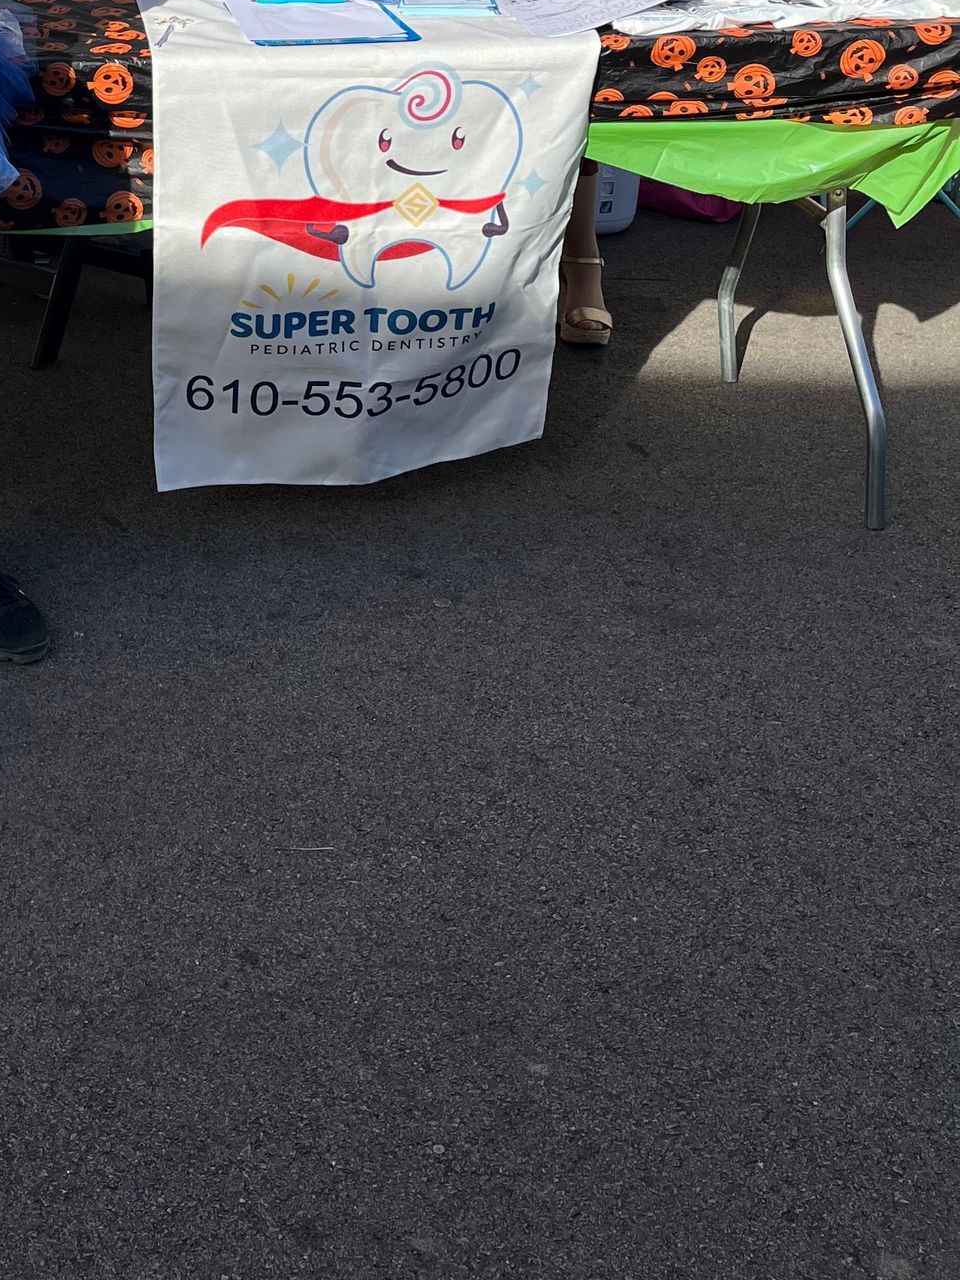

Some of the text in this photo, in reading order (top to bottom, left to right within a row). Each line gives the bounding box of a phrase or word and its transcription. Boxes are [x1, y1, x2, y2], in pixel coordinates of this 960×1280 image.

[230, 302, 497, 340] SUPER TOOTH
[250, 332, 483, 356] PEDIATRIC DENTISTRY
[186, 347, 523, 420] 610-553-5800
